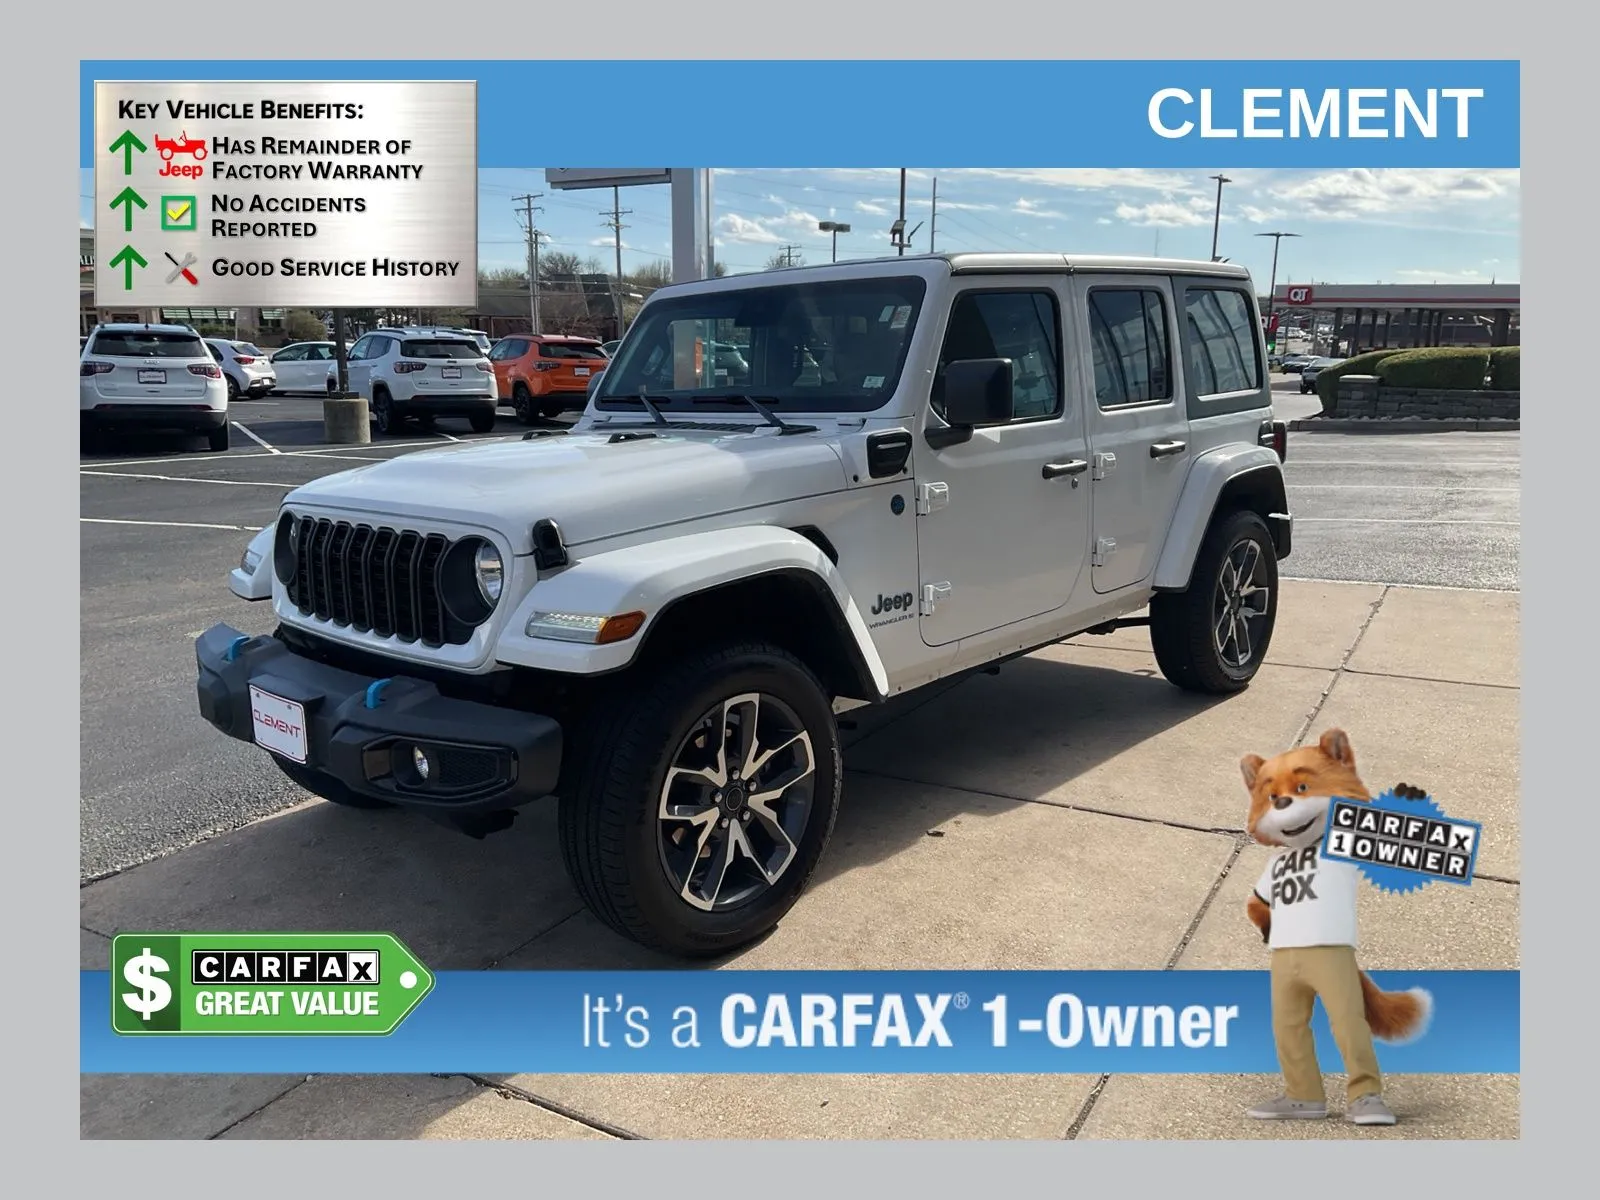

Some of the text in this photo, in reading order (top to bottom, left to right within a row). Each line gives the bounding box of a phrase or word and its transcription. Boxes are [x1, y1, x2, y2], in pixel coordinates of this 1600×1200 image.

[1290, 288, 1309, 302] QT
[871, 592, 914, 616] Jeep
[253, 708, 302, 739] CLEMENT
